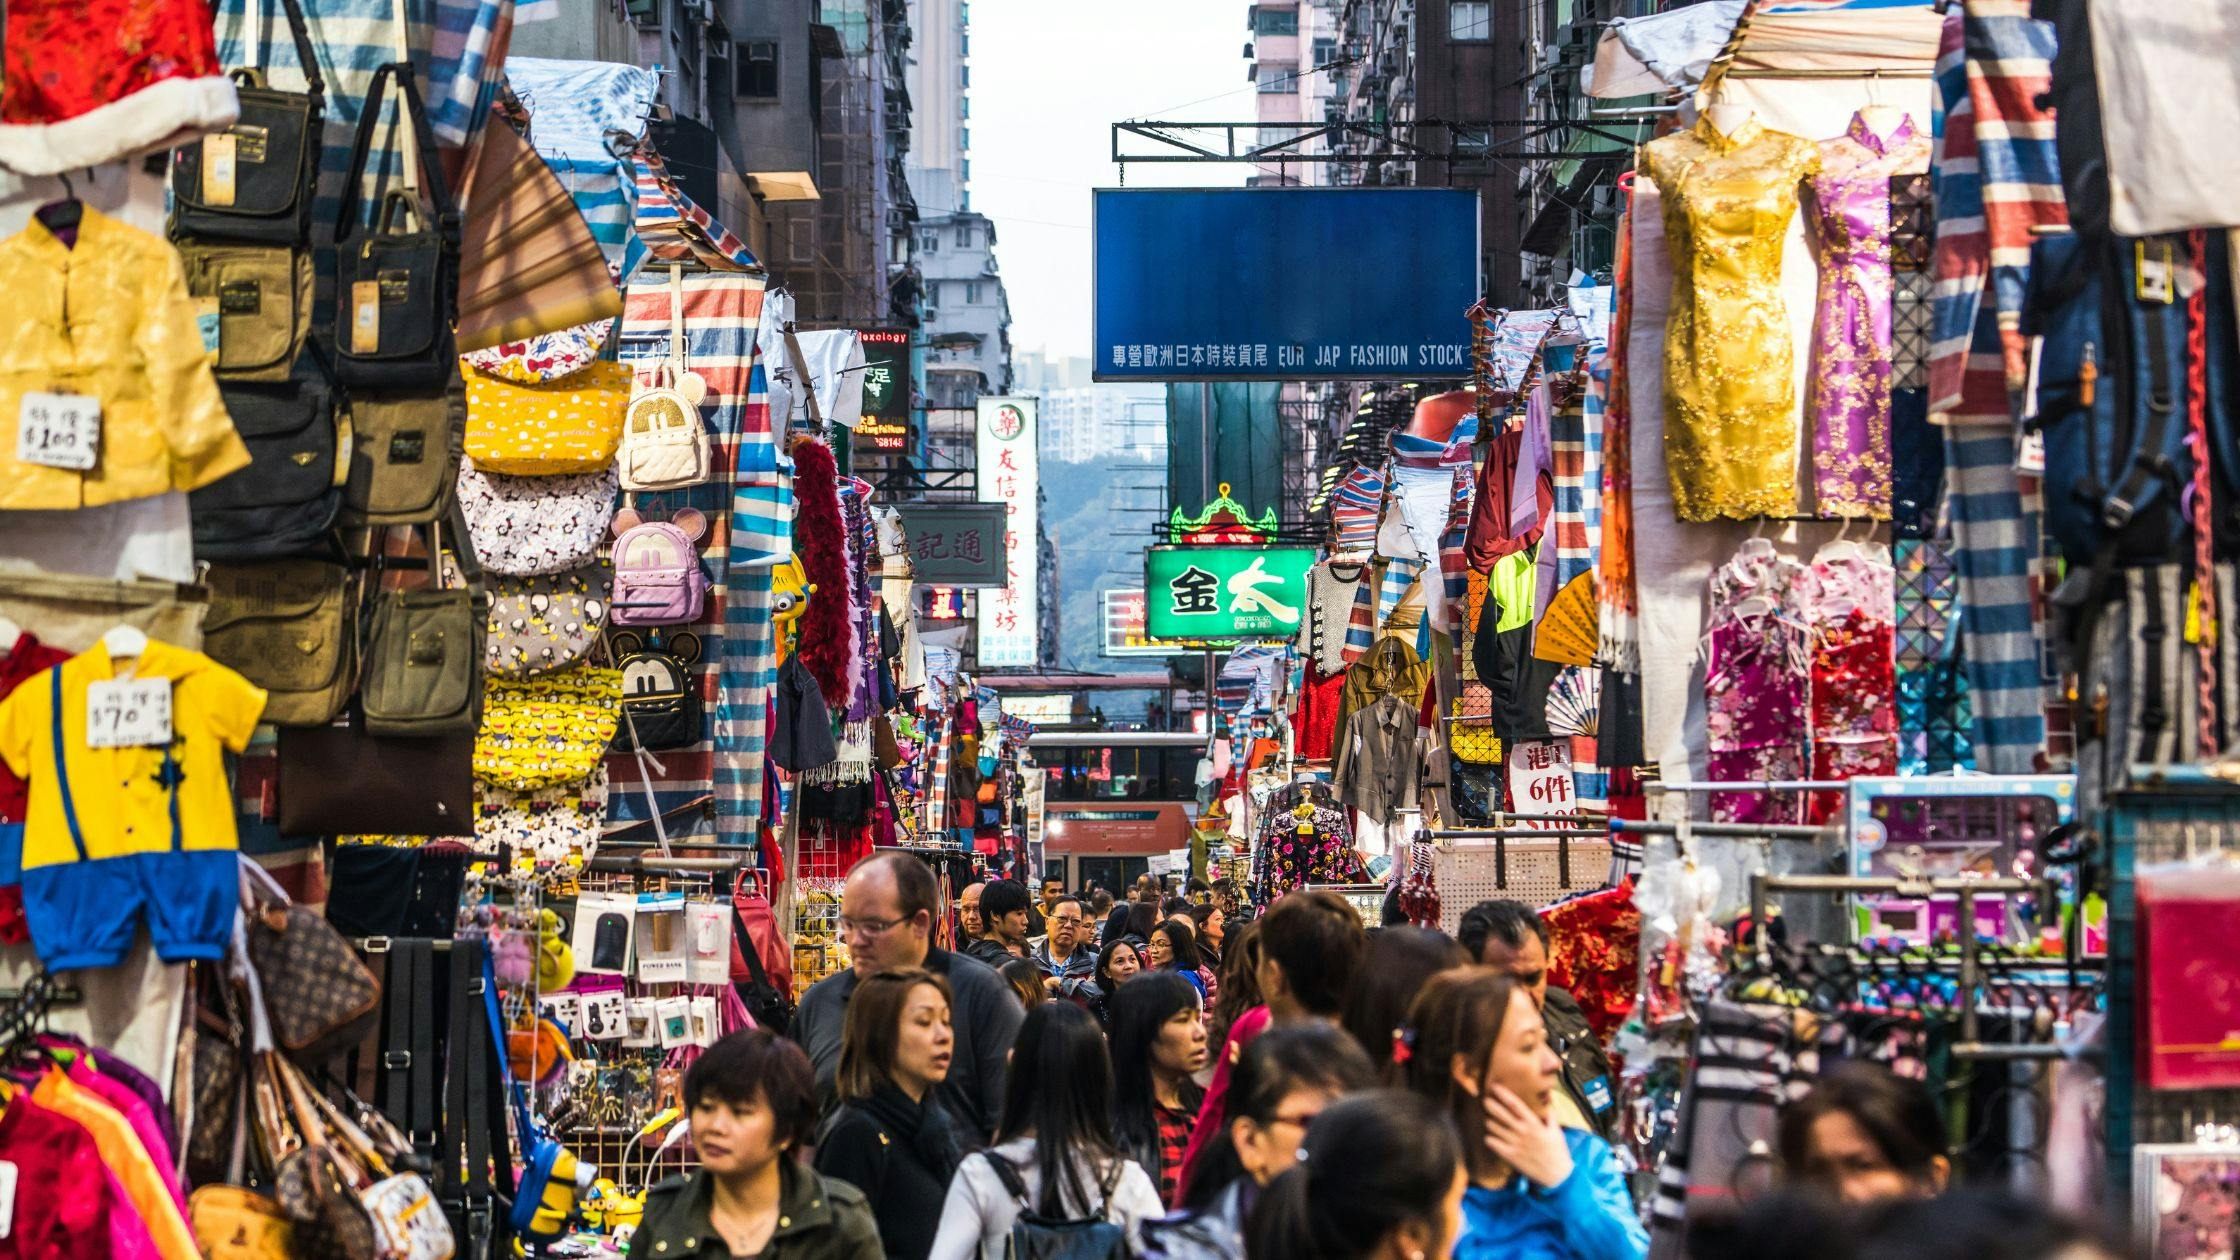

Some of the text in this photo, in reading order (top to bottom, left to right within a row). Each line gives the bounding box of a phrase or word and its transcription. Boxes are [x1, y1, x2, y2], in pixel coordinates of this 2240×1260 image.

[1112, 344, 1464, 368] 專營歐洲日本時裝貨尾 EUR JAP FASHION STOCK
[1170, 555, 1314, 624] 金太
[1529, 774, 1572, 804] 6件
